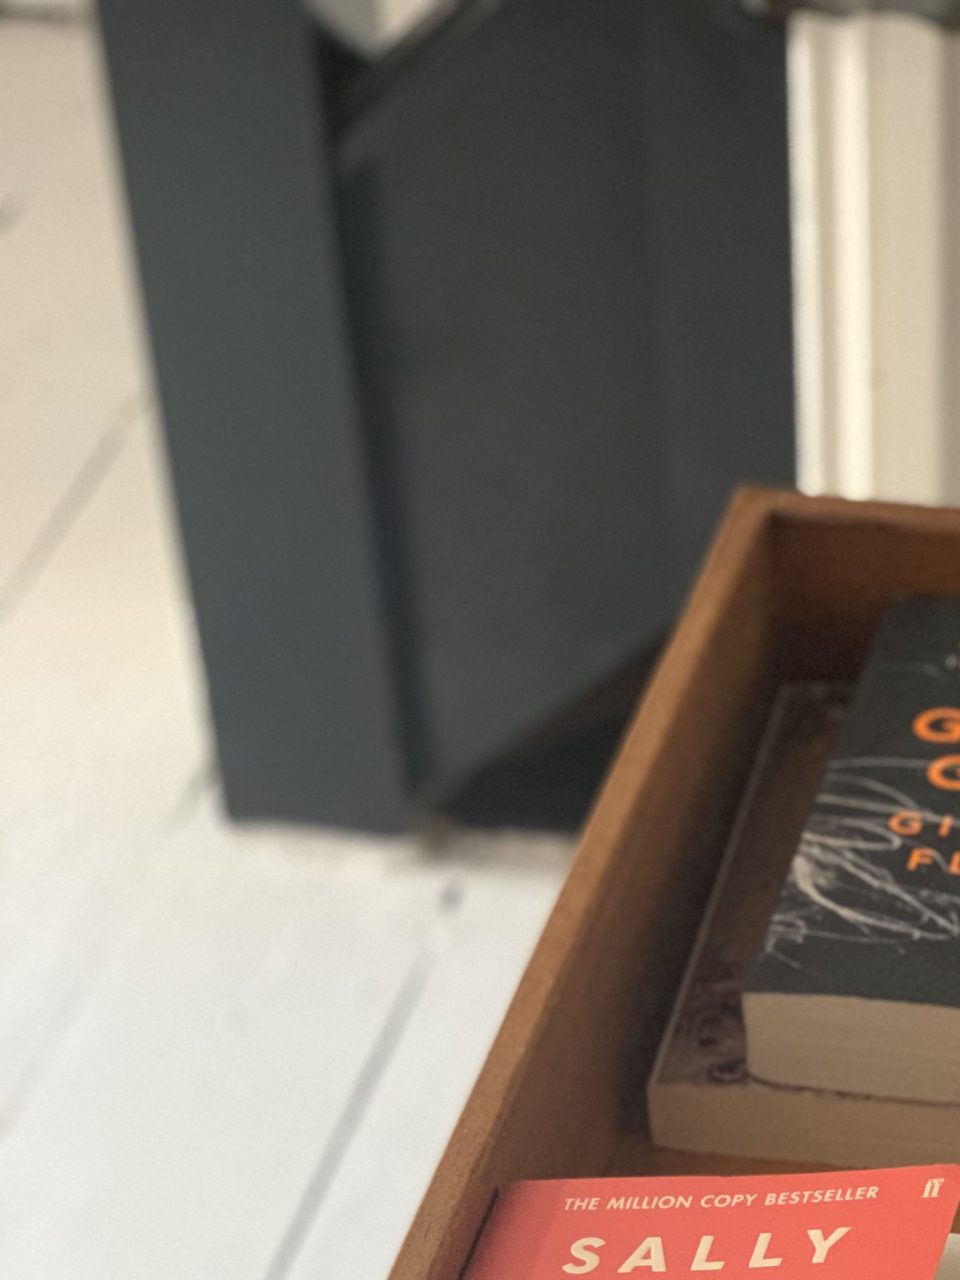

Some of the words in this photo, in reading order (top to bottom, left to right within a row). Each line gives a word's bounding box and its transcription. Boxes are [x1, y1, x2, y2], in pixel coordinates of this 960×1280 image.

[562, 1198, 600, 1213] THE
[606, 1195, 693, 1212] MILLION
[699, 1192, 758, 1210] COPY
[764, 1185, 881, 1207] BESTSELLER
[561, 1225, 853, 1276] SALLY
